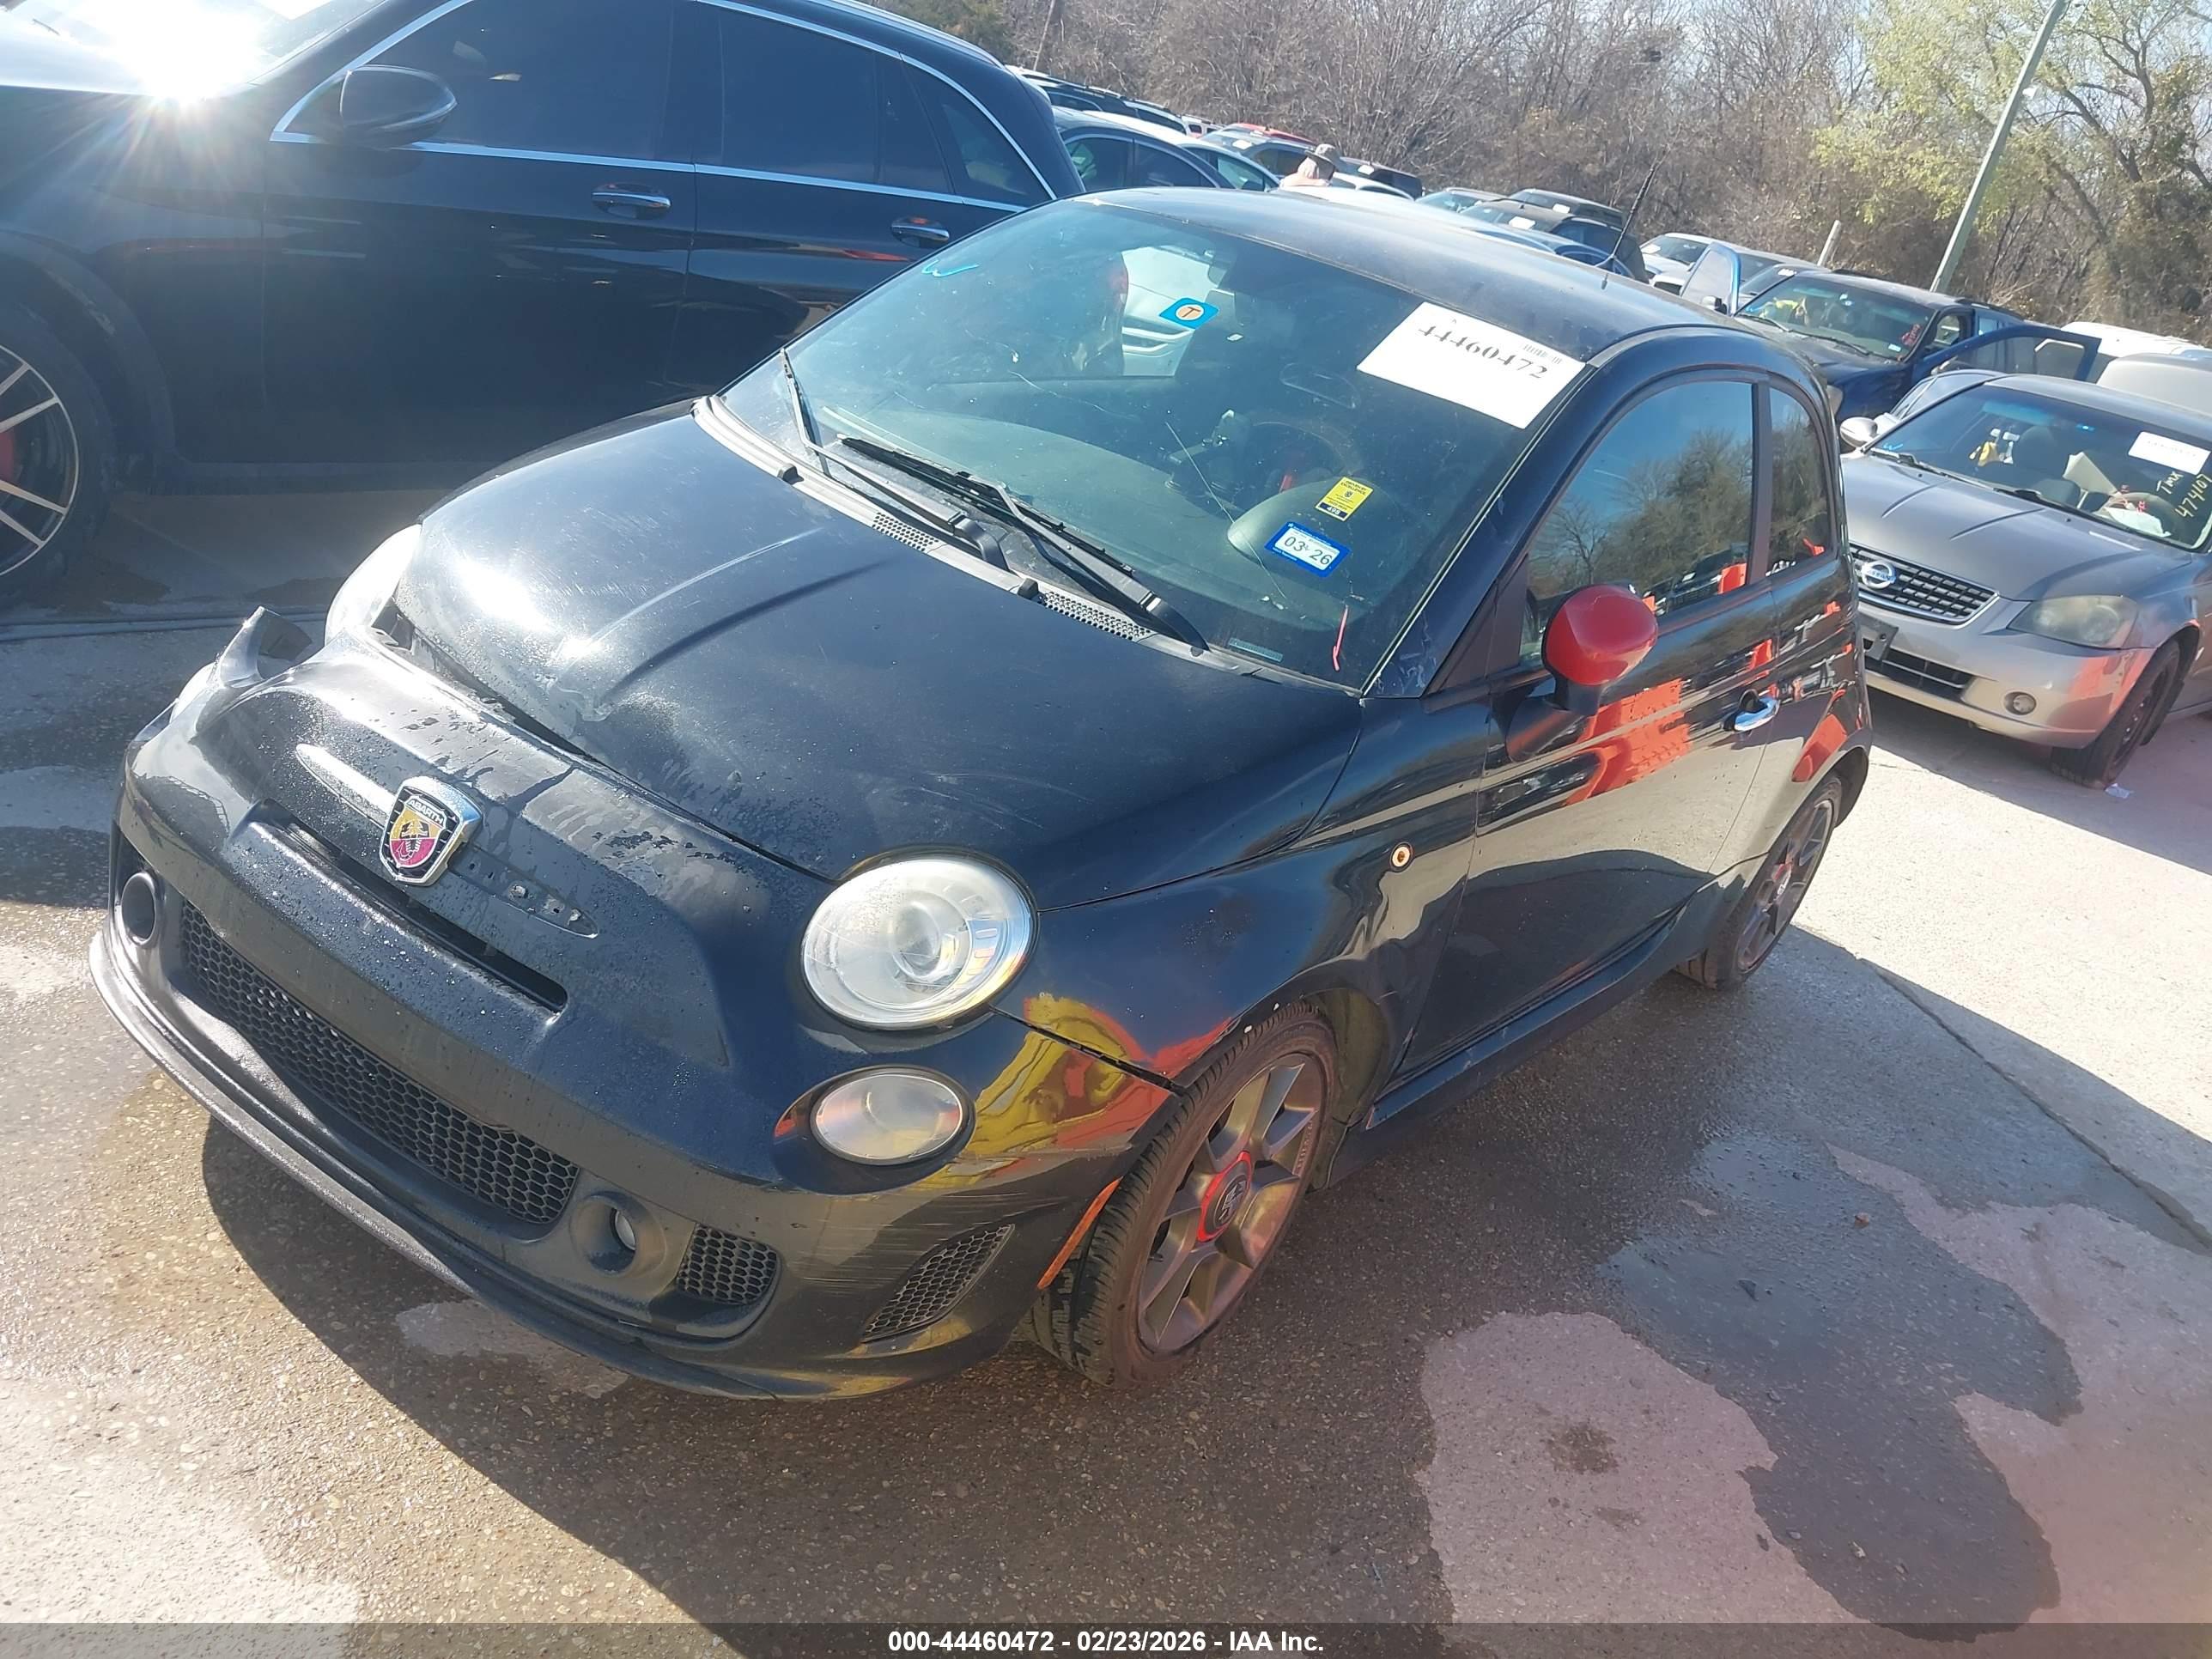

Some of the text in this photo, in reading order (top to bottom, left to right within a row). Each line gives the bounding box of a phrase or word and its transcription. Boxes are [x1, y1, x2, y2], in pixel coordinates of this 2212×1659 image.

[1418, 325, 1548, 379] 44460472
[2174, 473, 2212, 517] 474107
[1284, 536, 1306, 552] 03
[1309, 549, 1334, 565] 26
[408, 799, 445, 824] ABARTH
